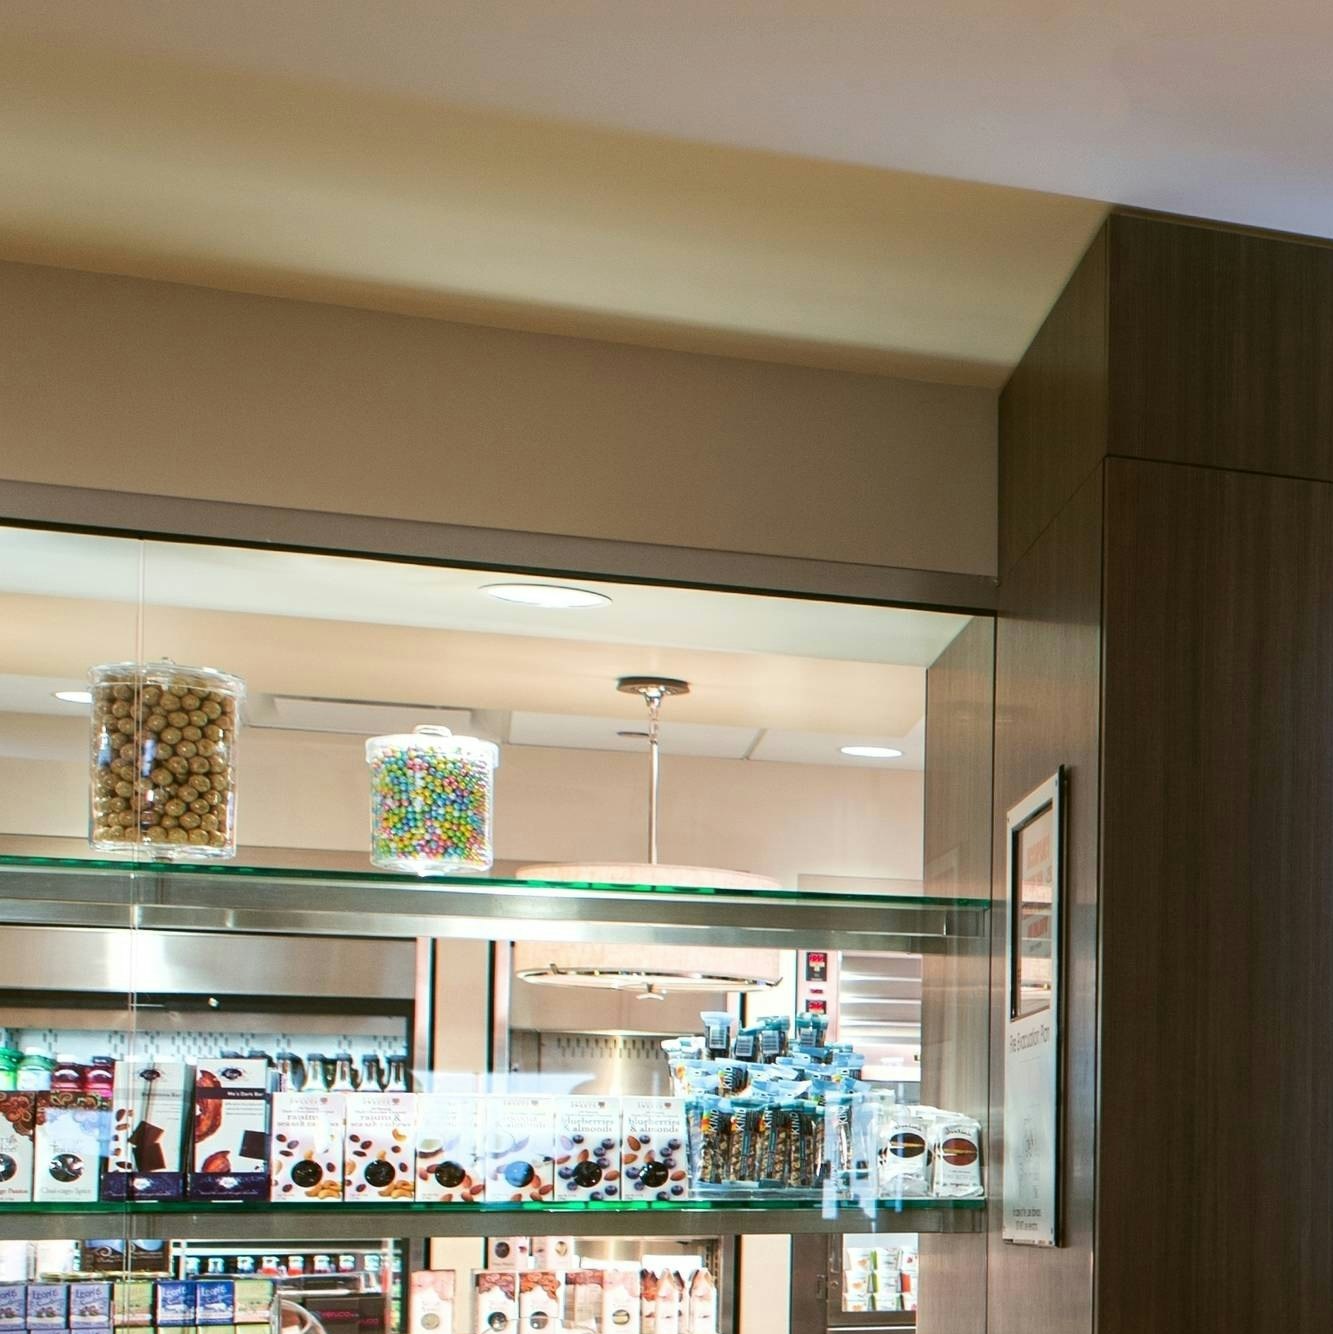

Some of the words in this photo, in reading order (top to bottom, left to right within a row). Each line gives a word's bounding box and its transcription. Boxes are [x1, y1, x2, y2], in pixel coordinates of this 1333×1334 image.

[723, 1067, 733, 1090] KIND
[710, 1109, 720, 1132] KIND
[736, 1108, 746, 1132] KIND
[790, 1112, 800, 1135] KIND
